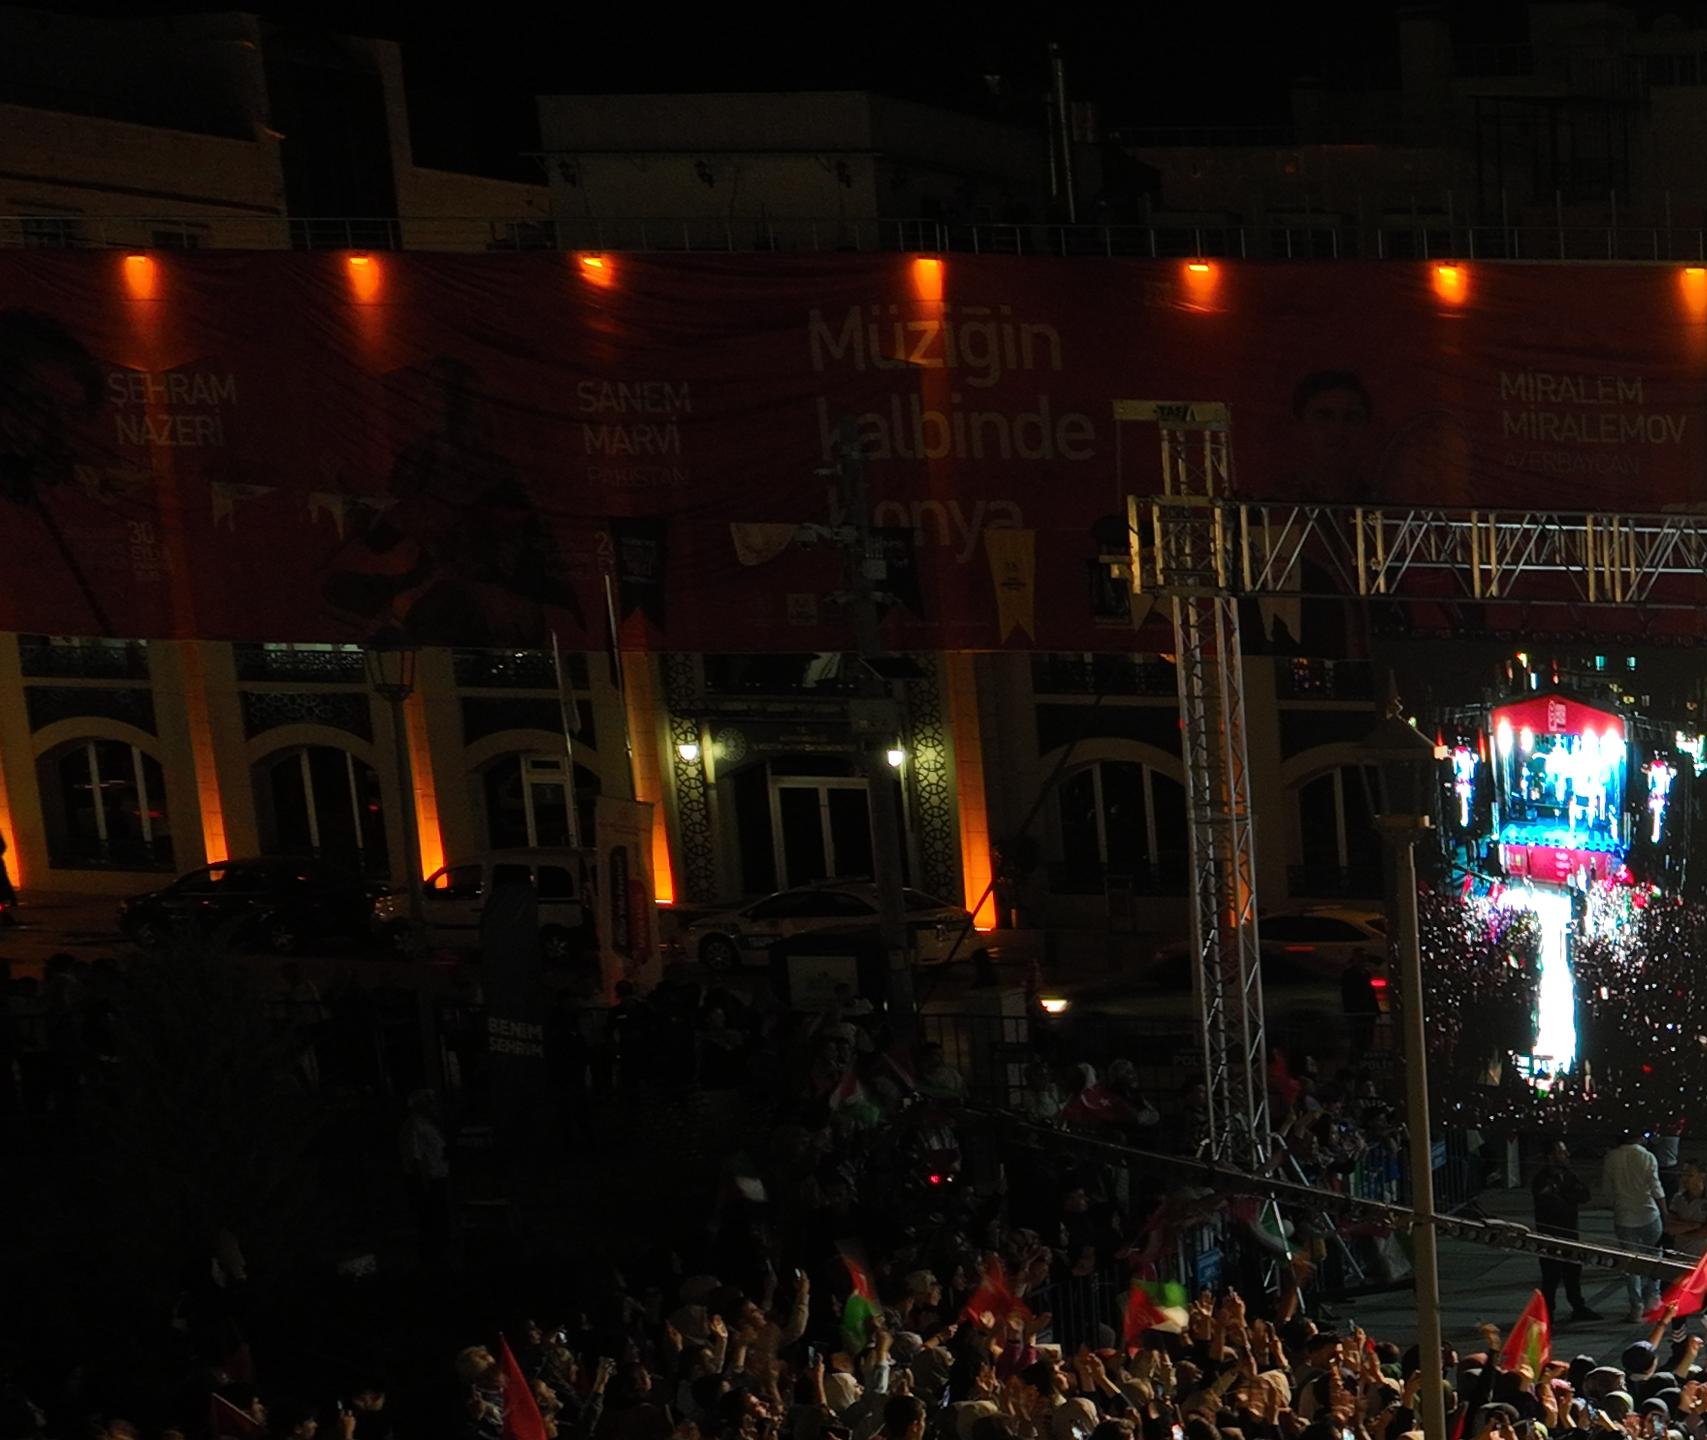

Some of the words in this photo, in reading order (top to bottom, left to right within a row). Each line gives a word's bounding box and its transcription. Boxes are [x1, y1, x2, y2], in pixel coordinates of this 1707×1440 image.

[576, 380, 692, 413] SANEM
[1500, 367, 1645, 404] MİRALEM
[583, 416, 682, 456] MARVİ
[1503, 405, 1687, 444] MİRALEMOV
